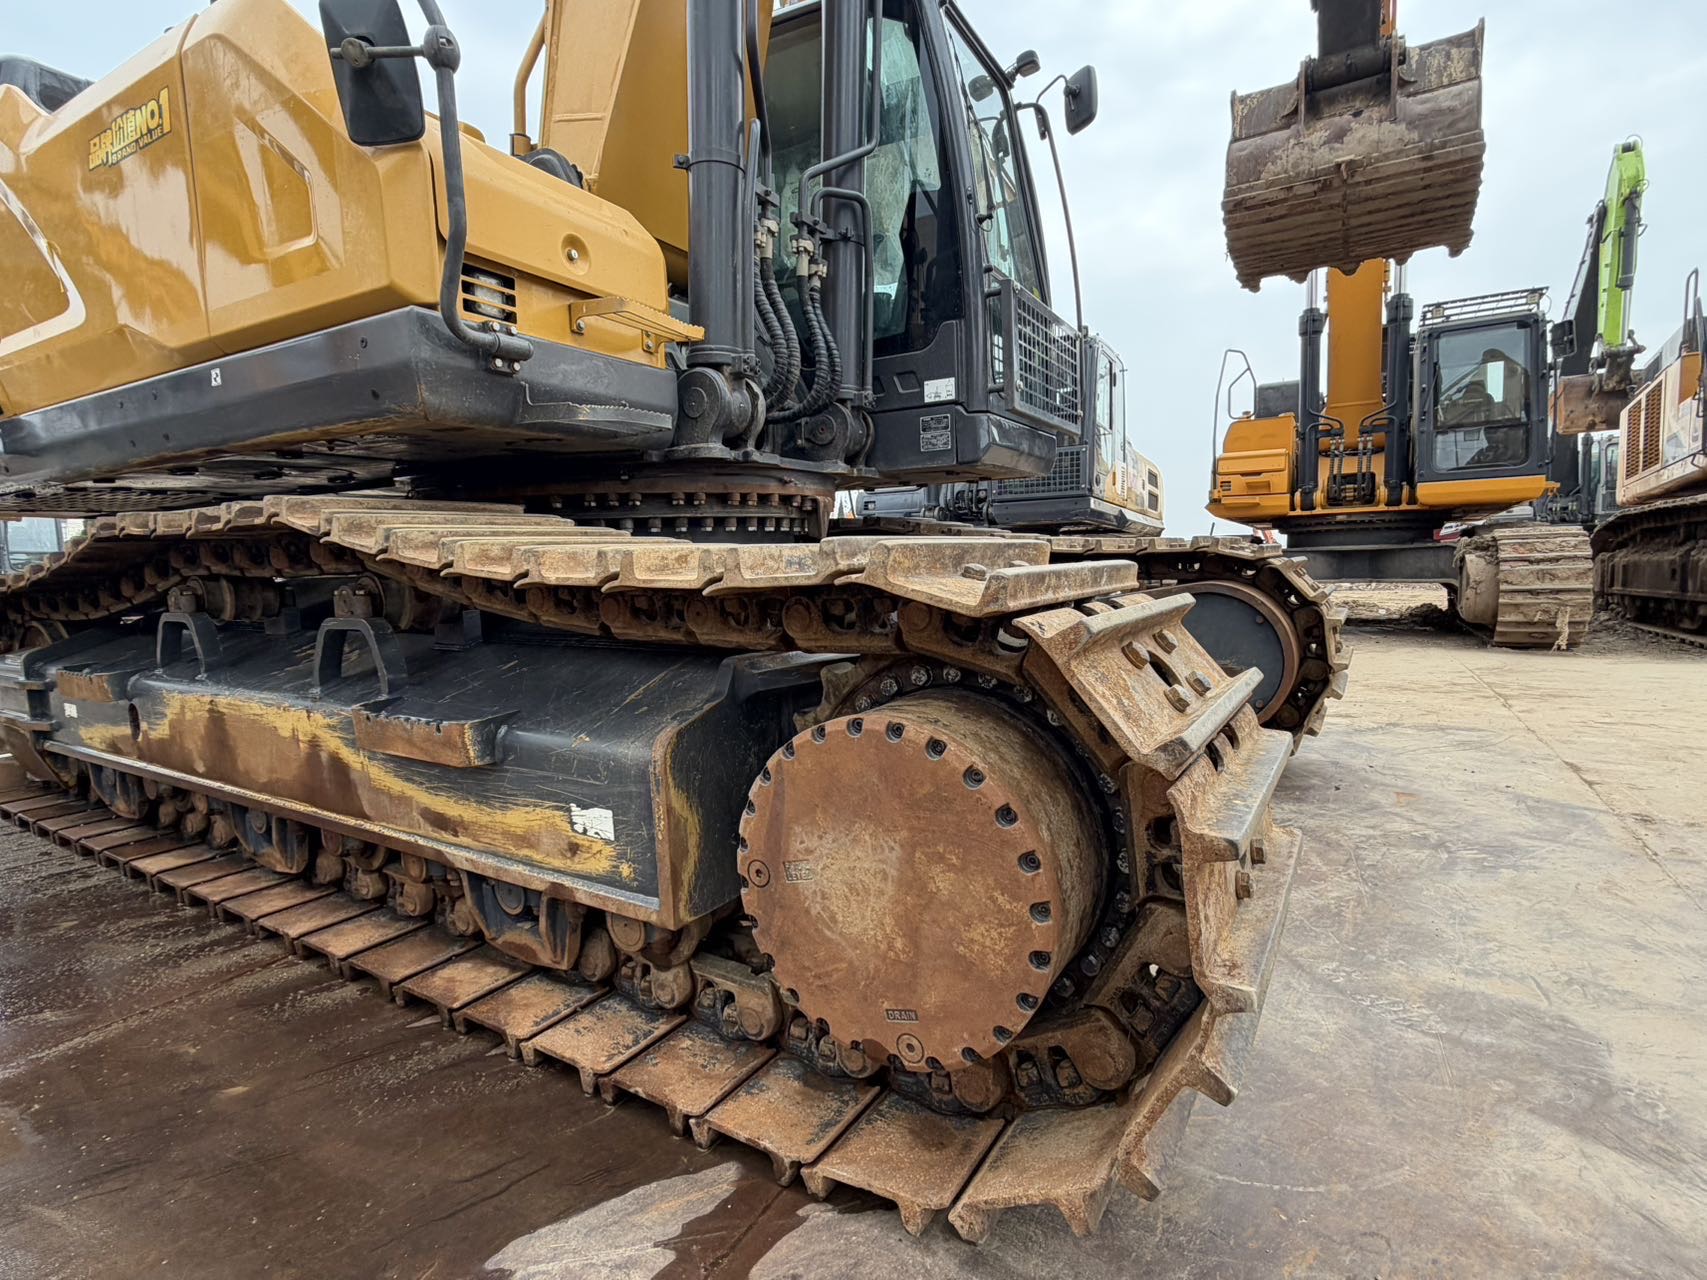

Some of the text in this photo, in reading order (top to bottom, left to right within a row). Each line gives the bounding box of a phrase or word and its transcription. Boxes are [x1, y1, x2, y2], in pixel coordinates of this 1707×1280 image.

[112, 126, 164, 164] BRAND VALUE
[887, 1010, 917, 1021] DRAIN
